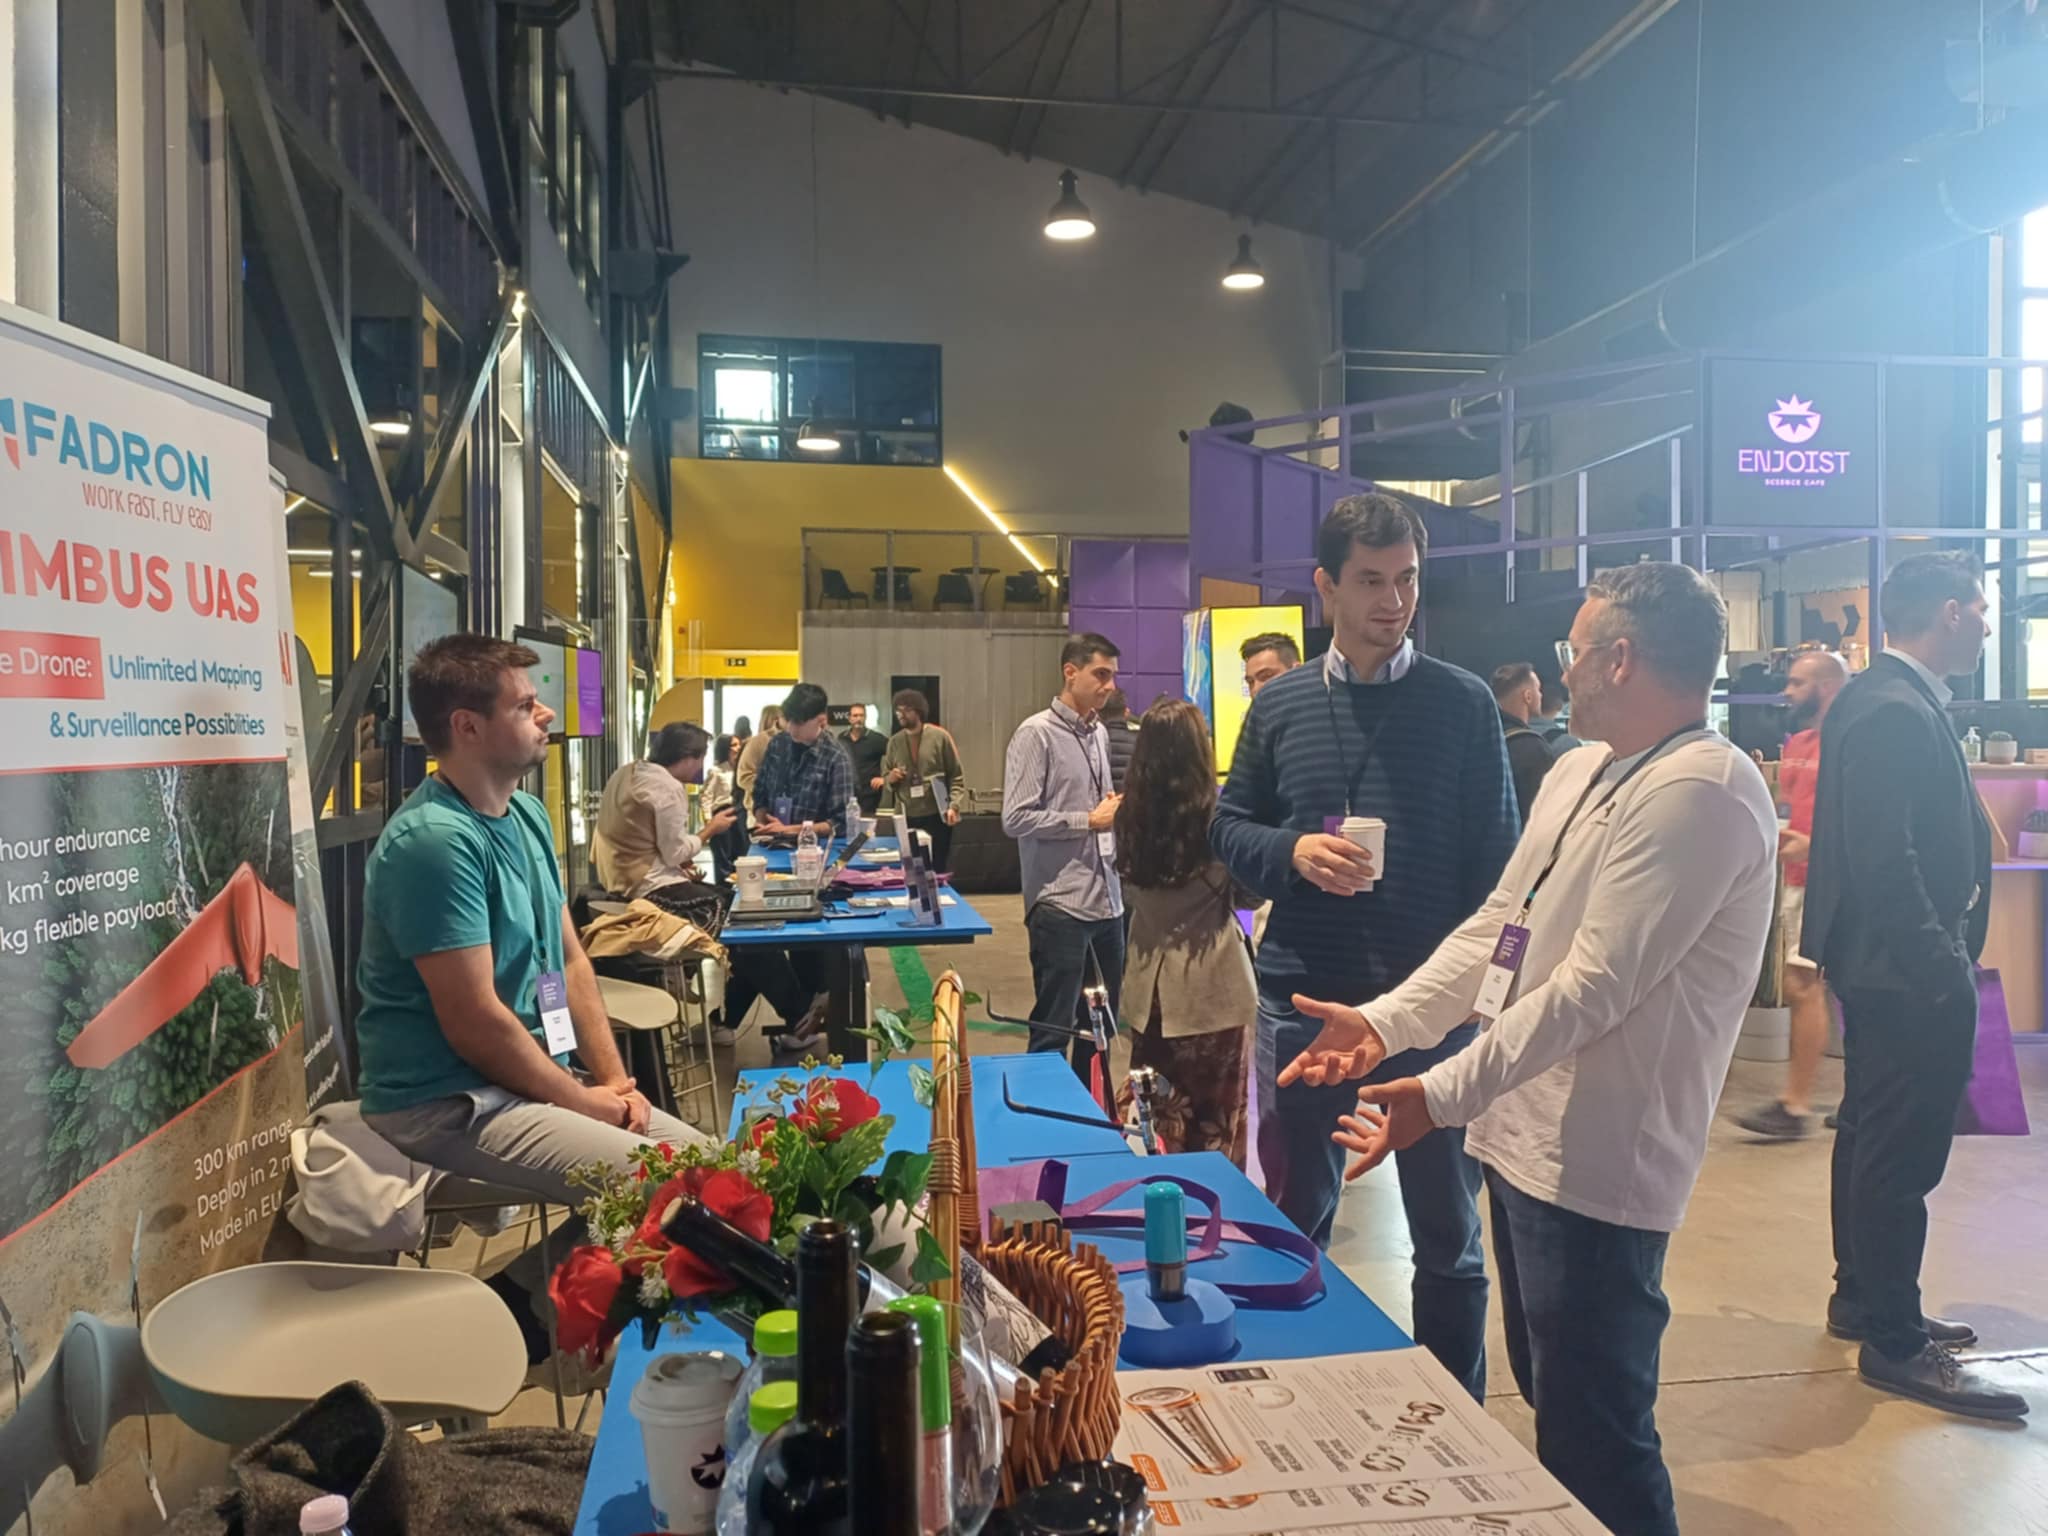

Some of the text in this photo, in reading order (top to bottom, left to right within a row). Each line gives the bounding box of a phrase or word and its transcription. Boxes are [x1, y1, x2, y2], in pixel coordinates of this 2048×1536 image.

[23, 401, 211, 501] FADRON
[1738, 449, 1851, 474] ENJOIST
[185, 561, 260, 624] UAS
[20, 647, 93, 679] Drone:
[108, 653, 198, 683] Unlimited
[201, 660, 262, 692] Mapping
[49, 711, 65, 738] &
[67, 711, 182, 738] Surveillance
[0, 826, 151, 862] hour endurance
[54, 866, 140, 897] coverage
[0, 892, 178, 955] kg flexible payload
[193, 1118, 293, 1181] 300 km range
[197, 1175, 248, 1218] Deploy
[250, 1167, 265, 1187] in
[268, 1157, 279, 1178] 2
[200, 1216, 243, 1256] Made
[244, 1207, 258, 1228] in
